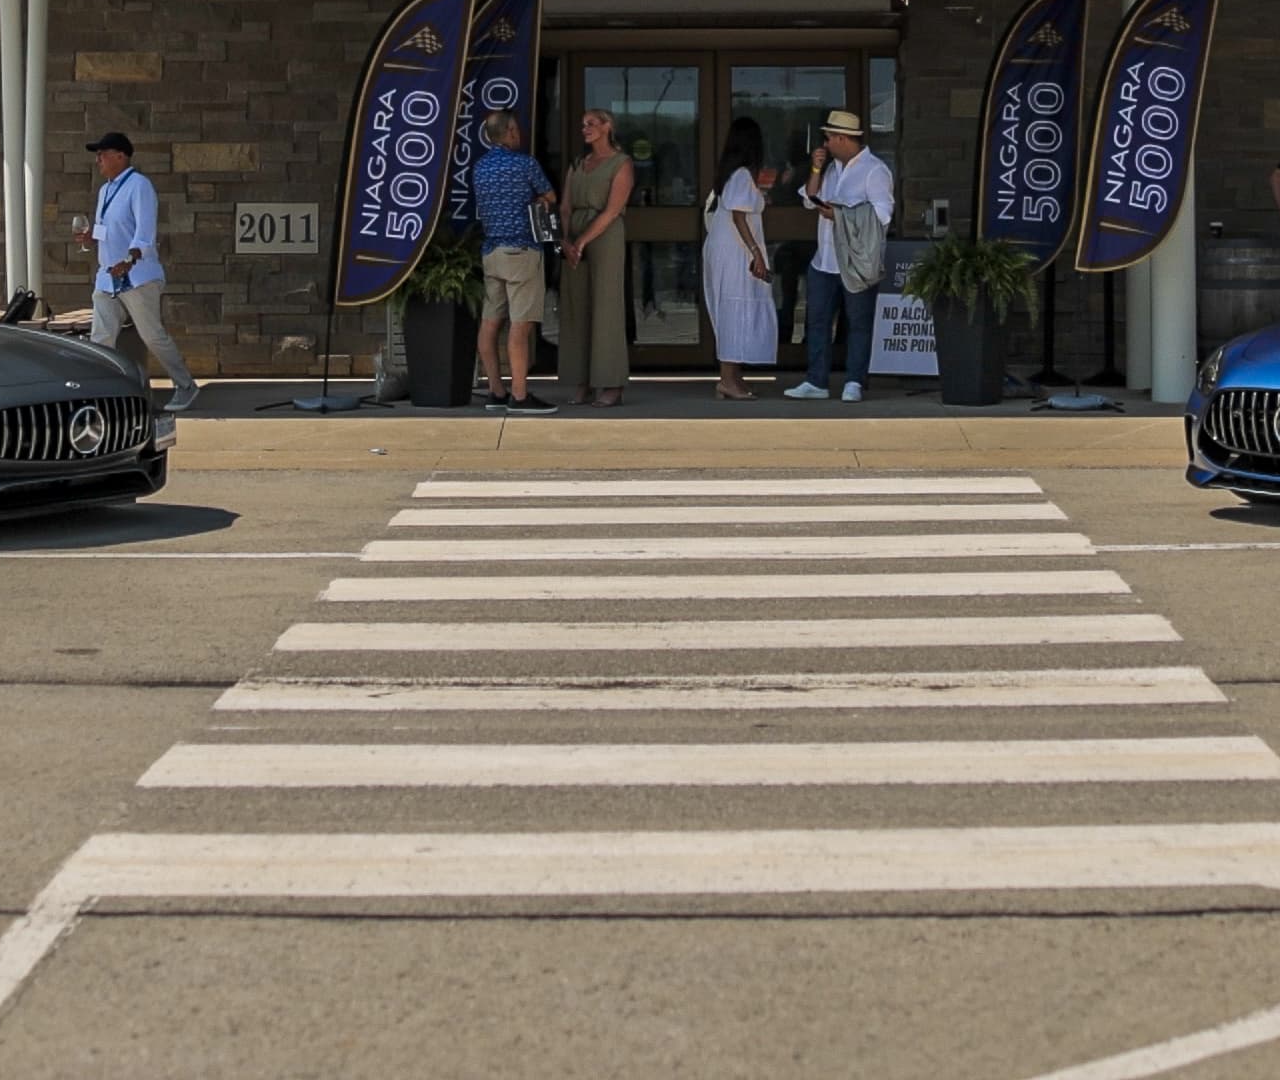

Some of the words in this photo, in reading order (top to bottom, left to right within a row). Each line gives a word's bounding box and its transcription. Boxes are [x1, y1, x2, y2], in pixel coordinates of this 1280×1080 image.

[359, 88, 397, 236] NIAGARA
[385, 90, 440, 241] 5000
[451, 79, 477, 220] NIAGARA
[997, 82, 1023, 220] NIAGARA
[1022, 81, 1065, 223] 5000
[1104, 62, 1145, 204] NIAGARA
[1128, 66, 1186, 214] 5000
[239, 212, 316, 244] 2011
[882, 306, 898, 320] NO
[883, 338, 908, 353] THIS
[910, 338, 937, 353] POIN
